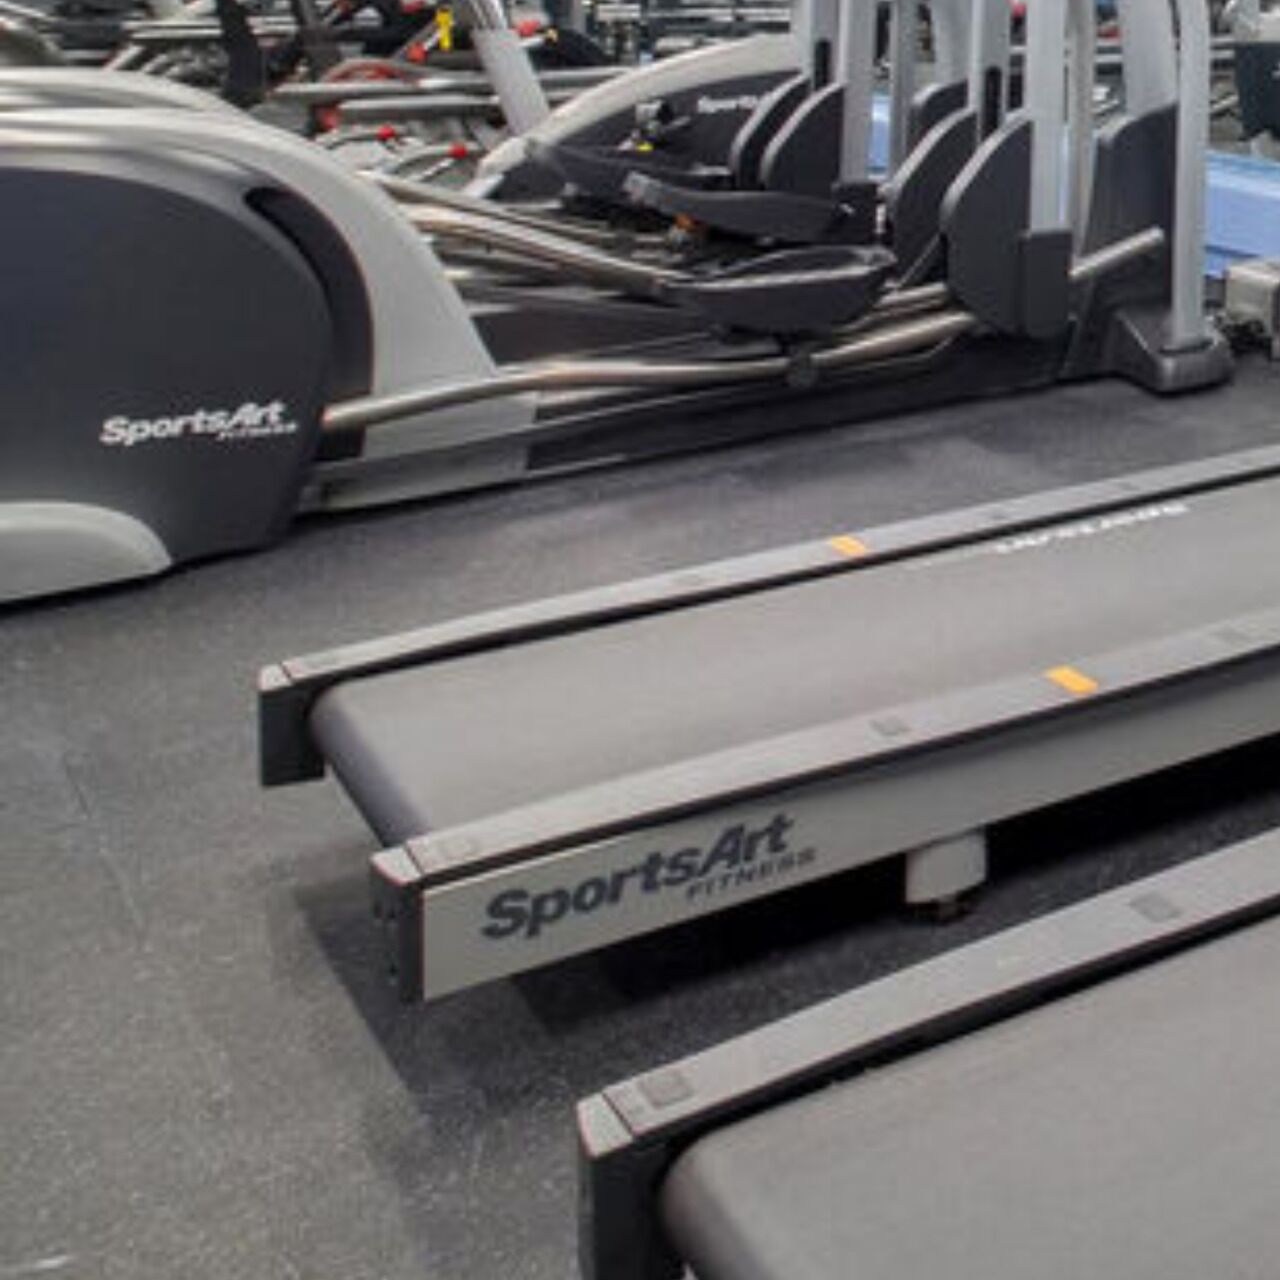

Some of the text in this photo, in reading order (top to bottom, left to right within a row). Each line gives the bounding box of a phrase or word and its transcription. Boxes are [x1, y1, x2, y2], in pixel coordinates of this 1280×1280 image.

[99, 400, 285, 447] SportsArt
[480, 812, 794, 940] SportsArt
[685, 846, 816, 901] FITNESS
